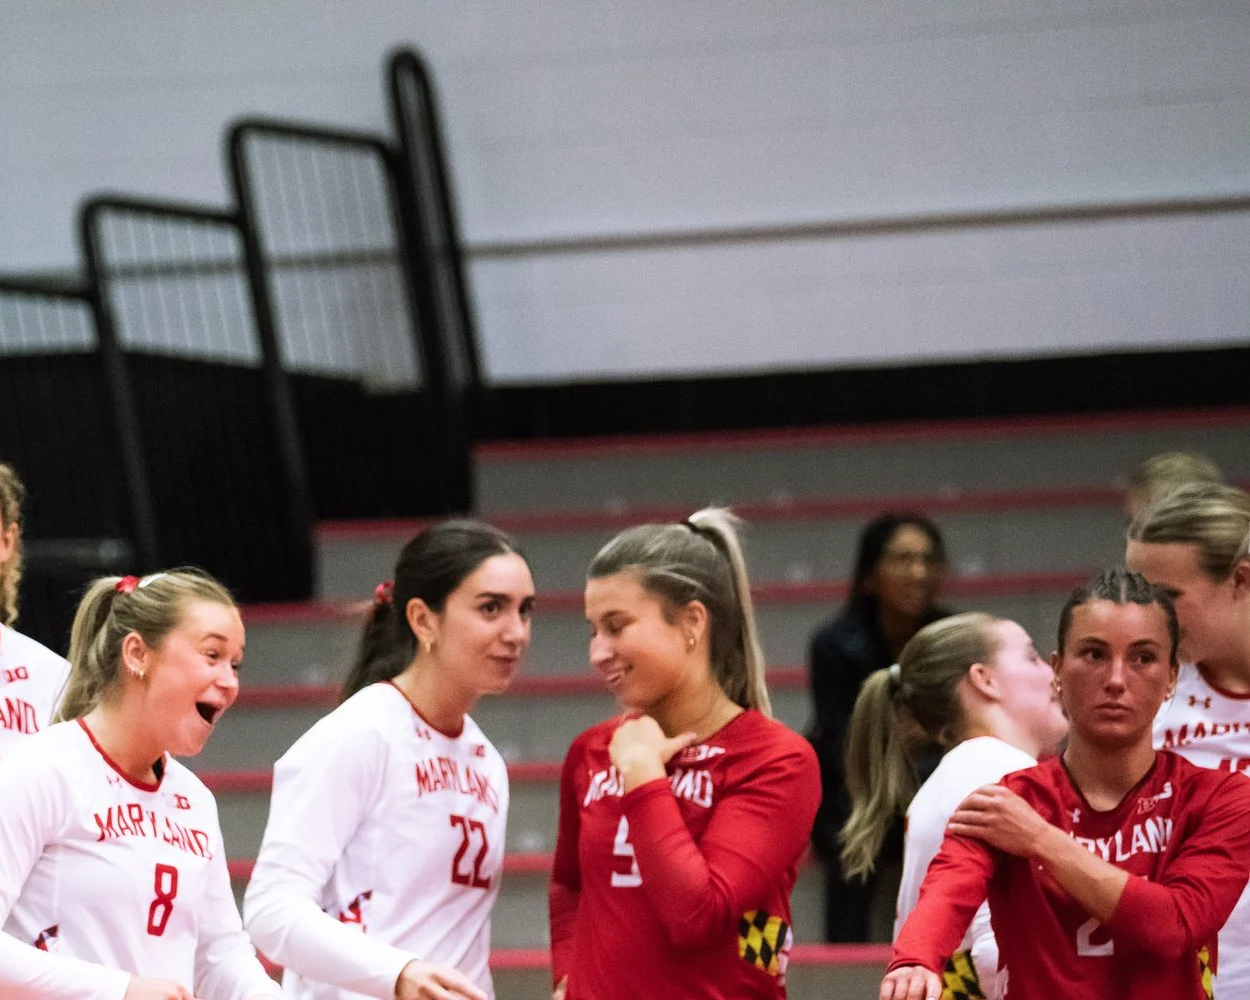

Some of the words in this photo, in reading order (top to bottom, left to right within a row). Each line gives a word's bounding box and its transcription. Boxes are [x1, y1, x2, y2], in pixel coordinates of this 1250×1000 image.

[414, 755, 499, 814] MARYLAND
[93, 803, 214, 861] MARYLAND
[449, 813, 493, 890] 22
[146, 862, 179, 937] 8
